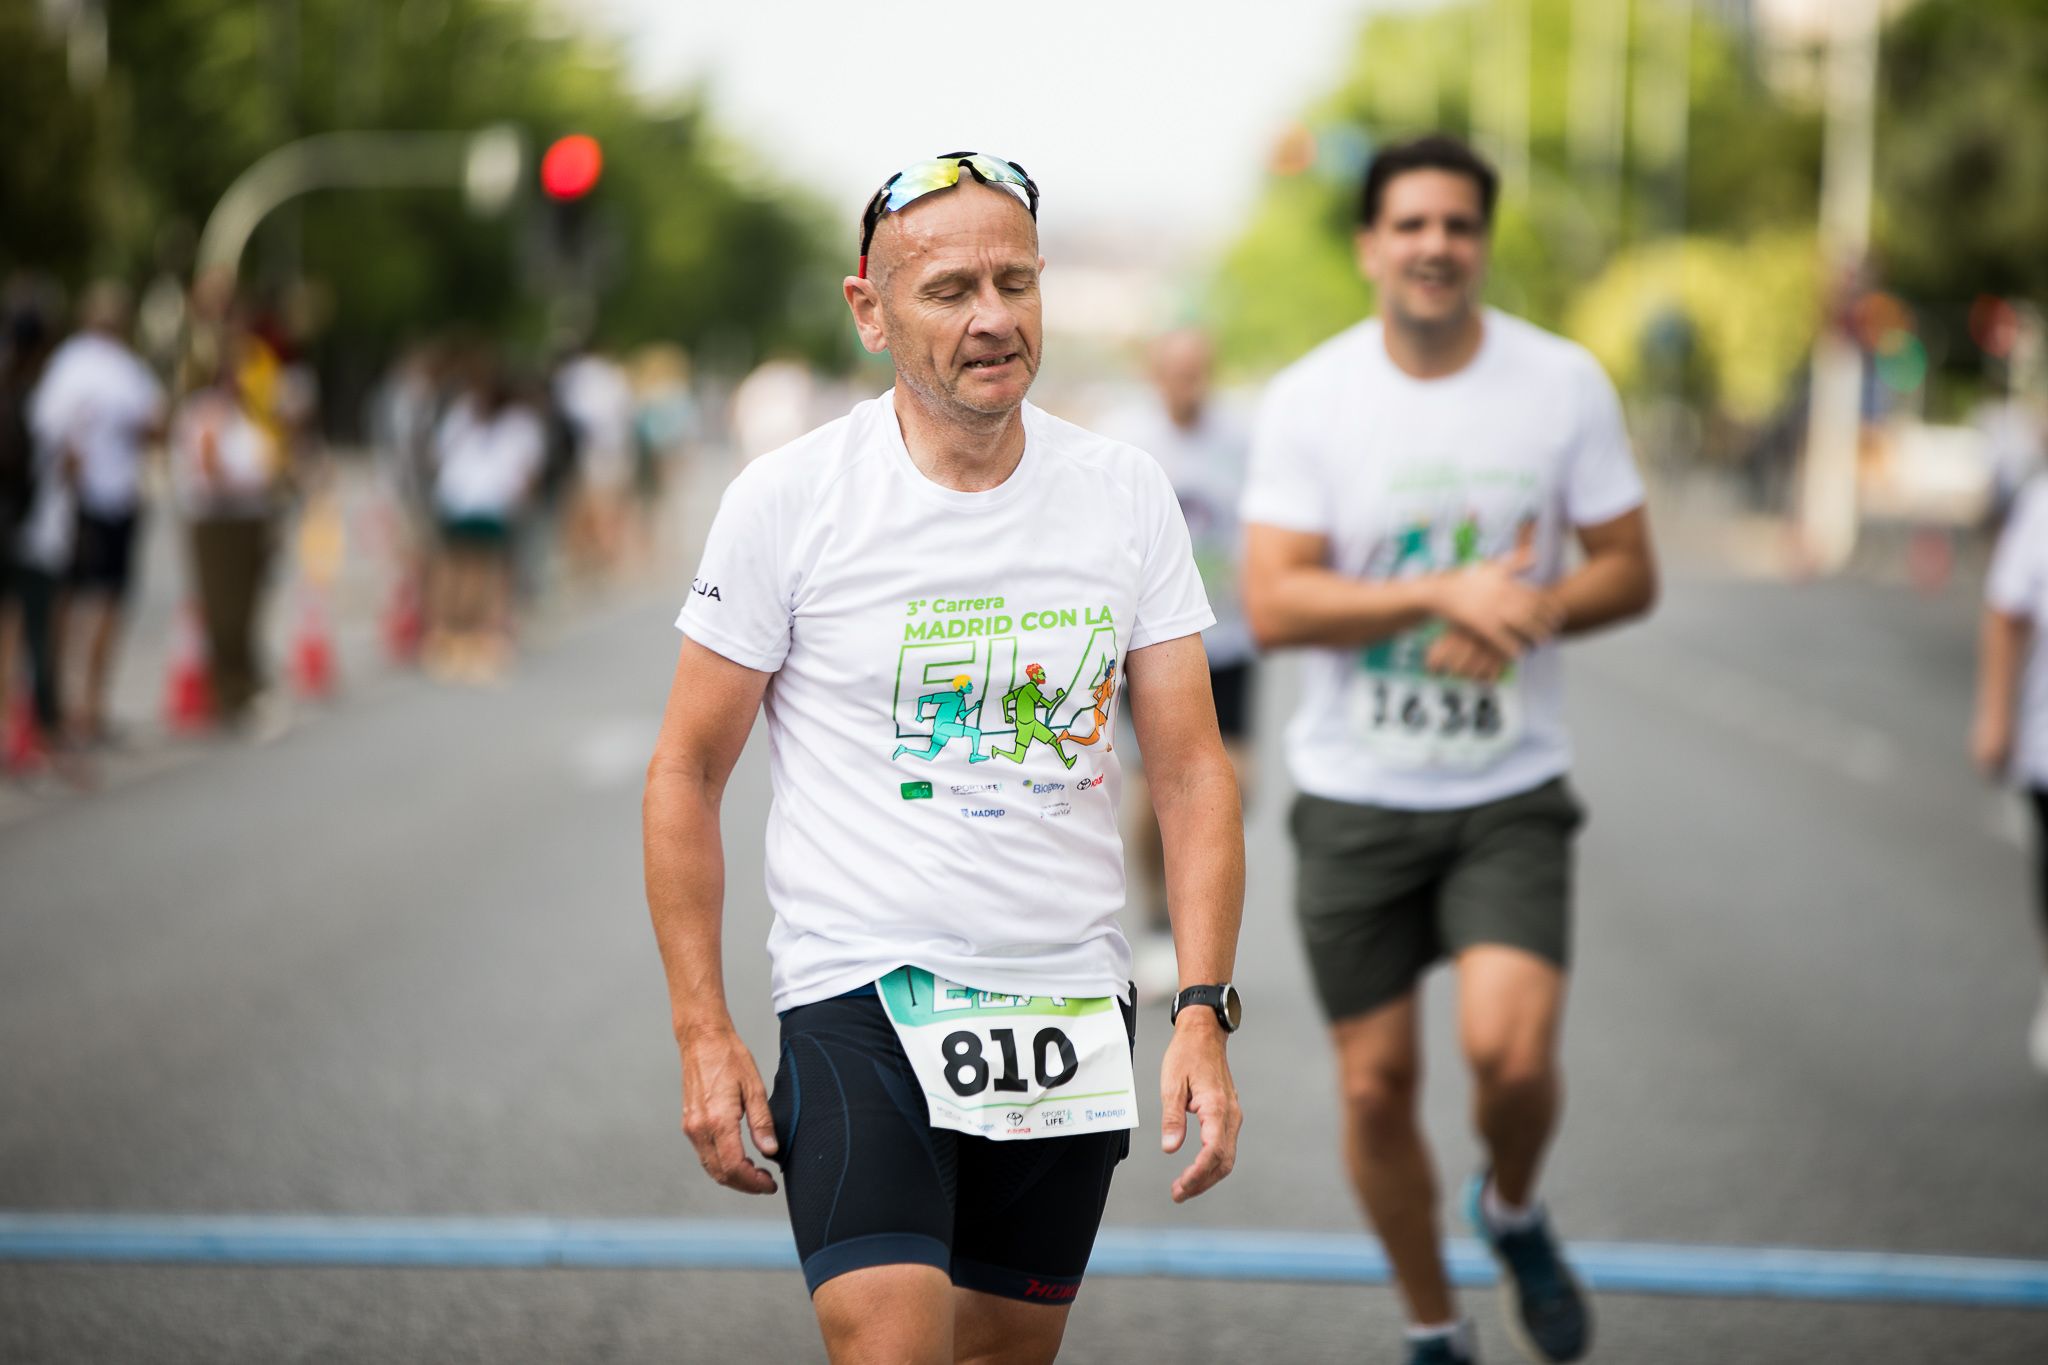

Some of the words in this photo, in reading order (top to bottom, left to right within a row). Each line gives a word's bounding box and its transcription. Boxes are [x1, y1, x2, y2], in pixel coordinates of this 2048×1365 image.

[932, 596, 1005, 614] Carrera
[904, 615, 1013, 641] MADRID
[1020, 609, 1077, 632] CON
[1085, 605, 1114, 626] LA
[1033, 783, 1065, 794] Biogen
[971, 809, 1006, 818] MADRID
[941, 1026, 1079, 1097] 810
[1041, 1109, 1066, 1119] SPORT
[1094, 1108, 1126, 1118] MADRID
[1045, 1117, 1065, 1126] LIFE
